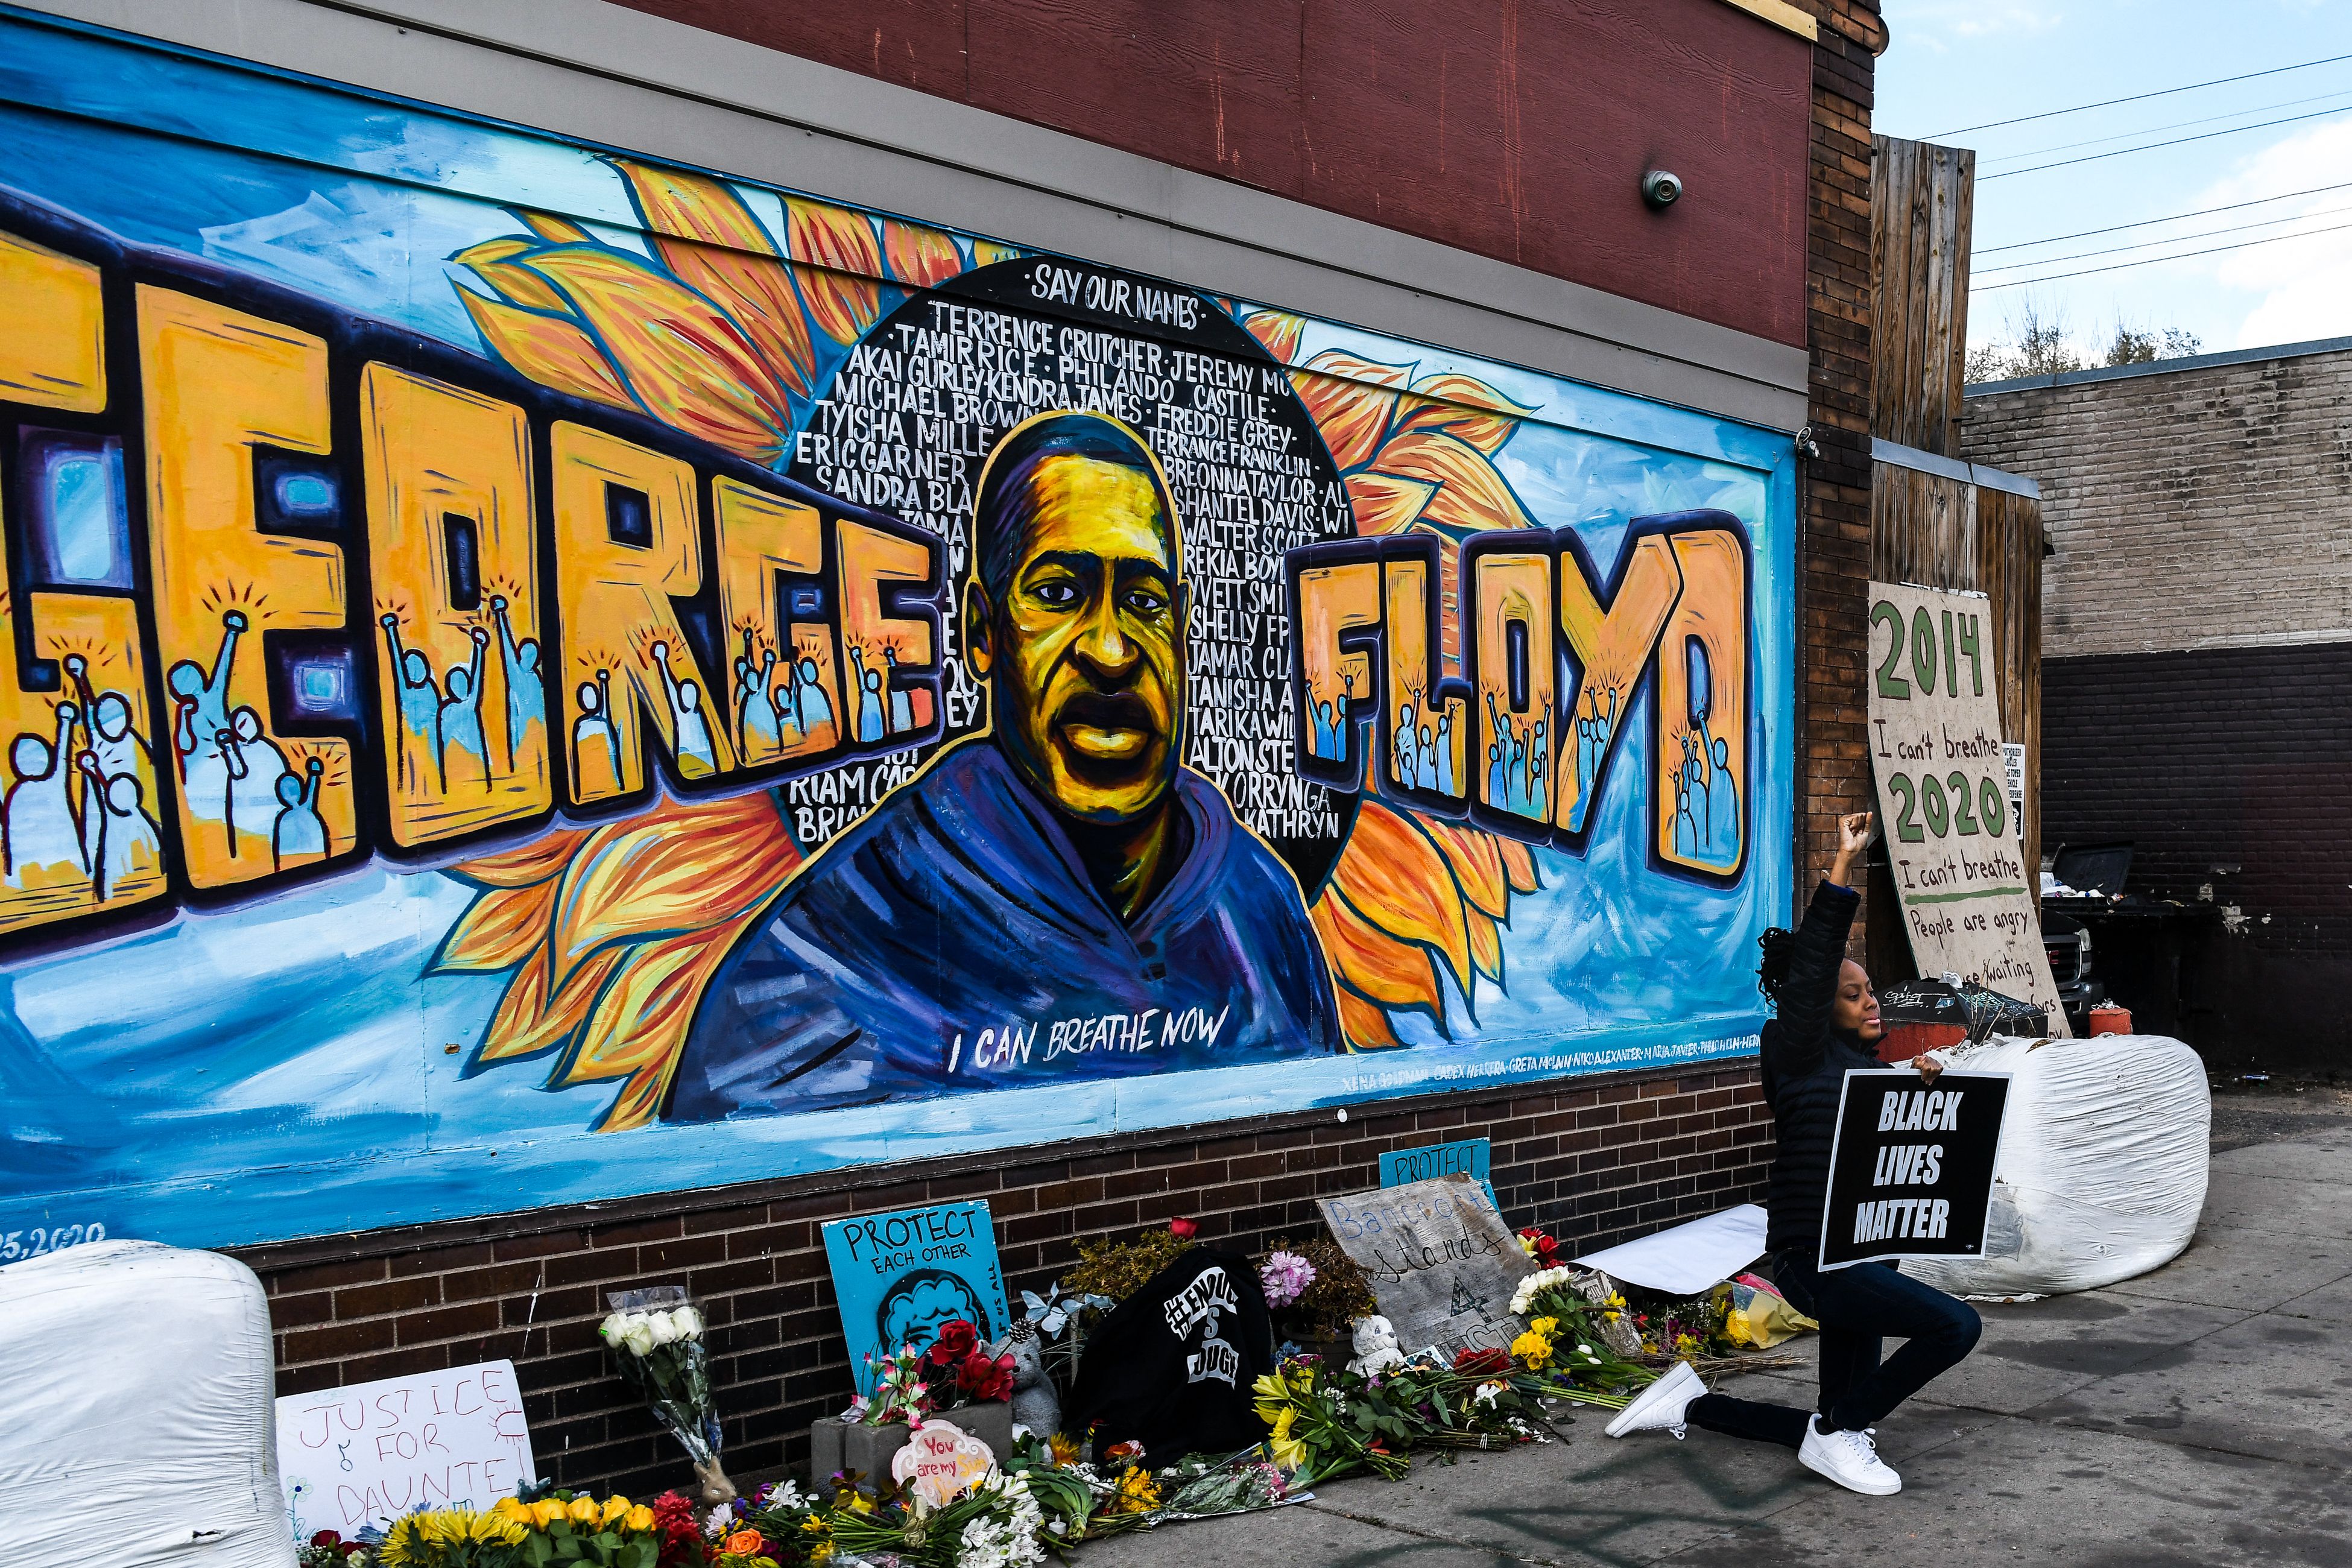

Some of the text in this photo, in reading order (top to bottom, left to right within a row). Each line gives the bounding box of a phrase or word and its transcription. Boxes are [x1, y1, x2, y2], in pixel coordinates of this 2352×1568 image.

[1031, 264, 1198, 330] SAY OUR NAMES
[932, 300, 1055, 356] TERRENCE
[1060, 326, 1163, 376] CRUTCHER
[1170, 351, 1255, 394] JEREMY
[895, 323, 1269, 423] TAMIR RICE PHILANDO CASTILE
[846, 344, 1292, 454] AKAI GURLEY KENDRA JAMES FREDDIE GREY
[835, 372, 946, 418] MICHAEL
[1144, 426, 1227, 464] TERRANCE
[1230, 443, 1310, 477] FRANKLIN
[815, 400, 1347, 508] TYISHA MILLE BREONNA TAYLOR AL
[797, 431, 1348, 534] ERIC GARNER SHANTEL DAVIS WI
[816, 466, 922, 511] SANDRA
[929, 480, 973, 516] BLA
[1178, 514, 1260, 553] WALTER
[1183, 544, 1240, 578] REKIA
[1186, 574, 1247, 610] YVETT
[1247, 581, 1283, 614] SMI
[1189, 604, 1260, 646] SHELLY
[1186, 640, 1258, 679] JAMAR
[1870, 599, 1984, 701] 2014
[1187, 675, 1275, 712] TANISHA
[1291, 516, 1751, 885] FLOYD
[1188, 707, 1263, 740] TARIKA
[1873, 719, 1999, 760] I can't breathe
[1189, 736, 1254, 774] ALTON
[1245, 809, 1339, 839] KATHRYN
[1888, 771, 2005, 844] 2020
[1898, 849, 2020, 889] I can't breathe
[1910, 909, 2028, 950] People are angry
[1986, 955, 2033, 988] waiting
[948, 1005, 1230, 1073] I CAN BREATHE NOW
[1509, 1056, 1537, 1072] GRETA
[1877, 1090, 1964, 1131] BLACK
[1394, 1145, 1478, 1186] PROTECT
[1873, 1145, 1944, 1186] LIVES
[842, 1210, 976, 1262] PROTECT
[1853, 1199, 1950, 1244] MATTER
[871, 1243, 972, 1275] EACH OTHER
[1450, 1276, 1490, 1324] 4
[300, 1371, 508, 1449] JUSTICE
[376, 1423, 449, 1462] FOR
[917, 1463, 939, 1477] are
[940, 1461, 956, 1478] my
[338, 1459, 513, 1526] DAUNTE
